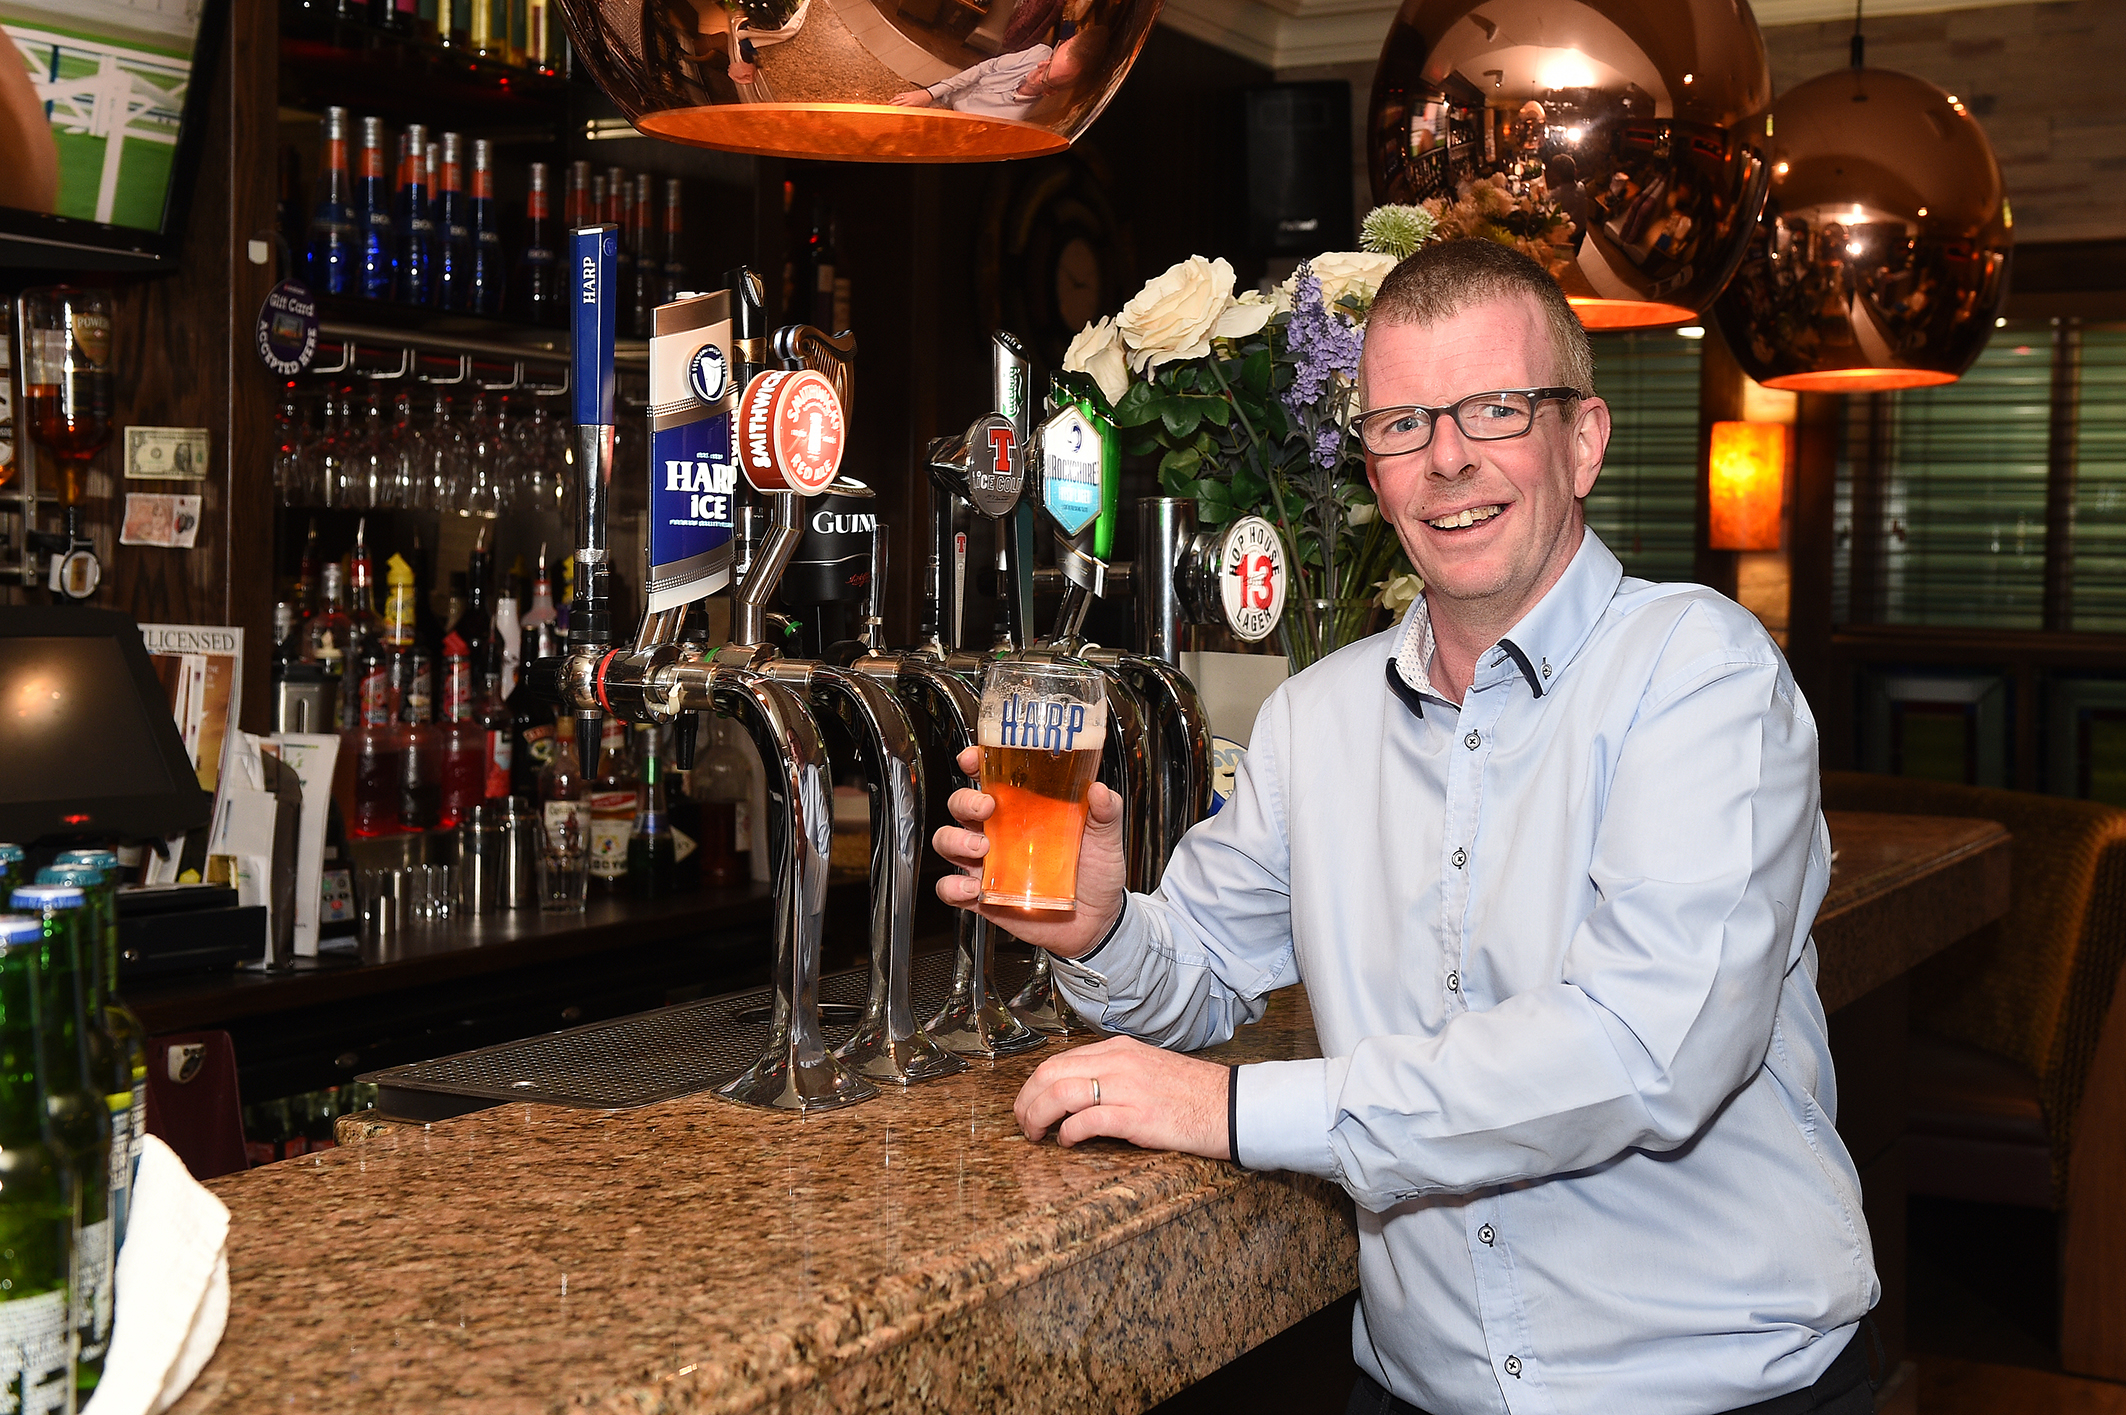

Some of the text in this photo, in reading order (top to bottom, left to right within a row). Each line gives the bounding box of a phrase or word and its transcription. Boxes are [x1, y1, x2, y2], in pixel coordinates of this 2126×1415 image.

[582, 256, 597, 305] HARP
[269, 293, 315, 317] Gift Card
[298, 326, 318, 367] HERE
[790, 453, 833, 481] RED ALE
[690, 494, 727, 520] ICE
[1229, 526, 1280, 577] HOP HOUSE
[1236, 553, 1274, 610] 13
[1236, 607, 1272, 632] LAGER
[147, 629, 235, 651] LICENSED
[1001, 692, 1085, 757] HARP
